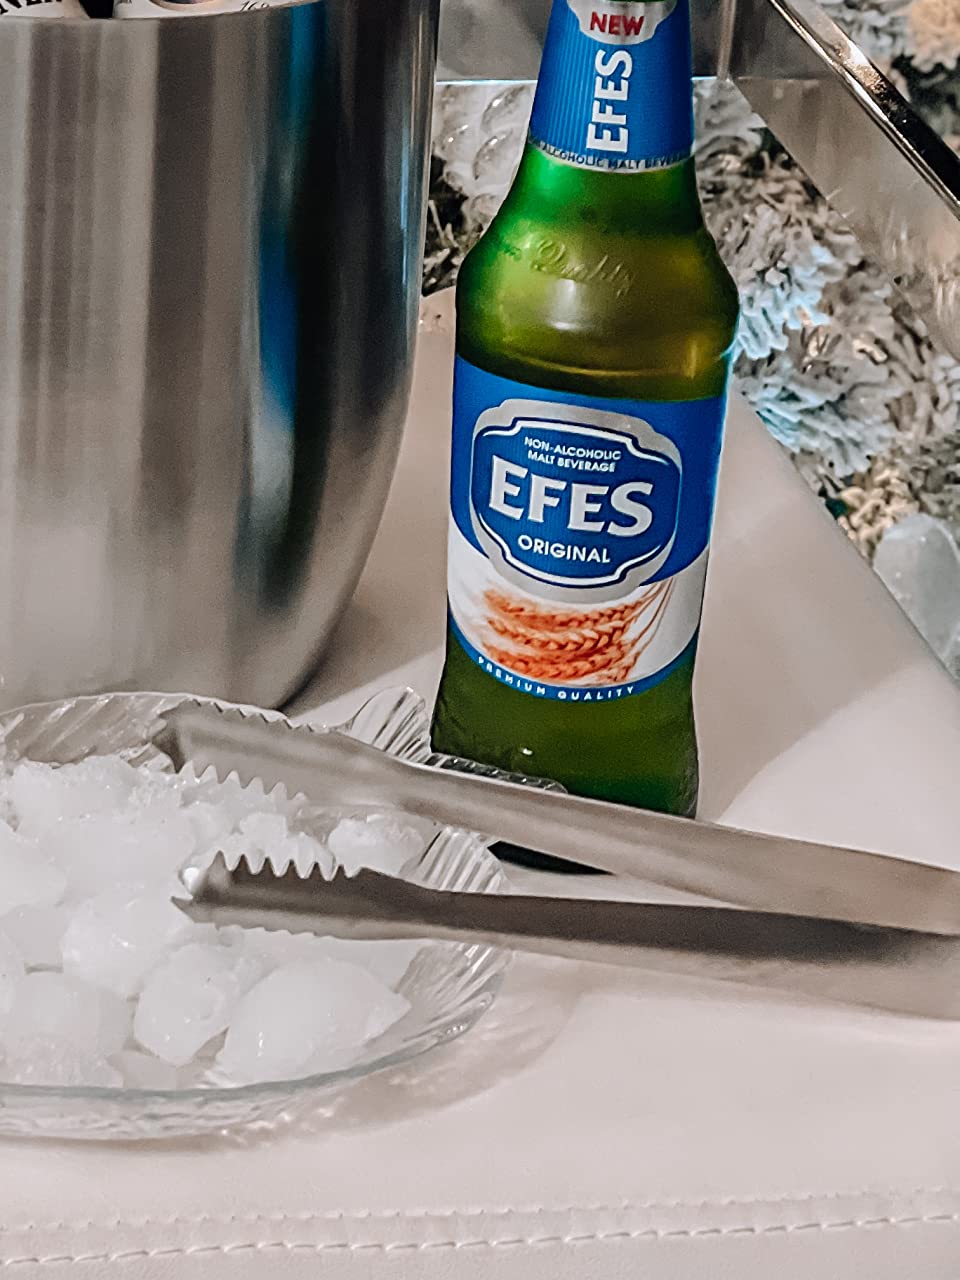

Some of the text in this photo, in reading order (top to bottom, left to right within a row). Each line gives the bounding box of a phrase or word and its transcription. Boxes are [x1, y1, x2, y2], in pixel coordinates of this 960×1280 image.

[590, 11, 644, 36] NEW
[586, 49, 633, 153] EFES
[524, 436, 621, 460] NON-ALCOHOLIC
[527, 450, 616, 473] MALT BEVERAGE
[489, 455, 654, 538] EFES
[517, 535, 611, 564] ORIGINAL
[478, 656, 634, 701] PREMIUM QUALITY
